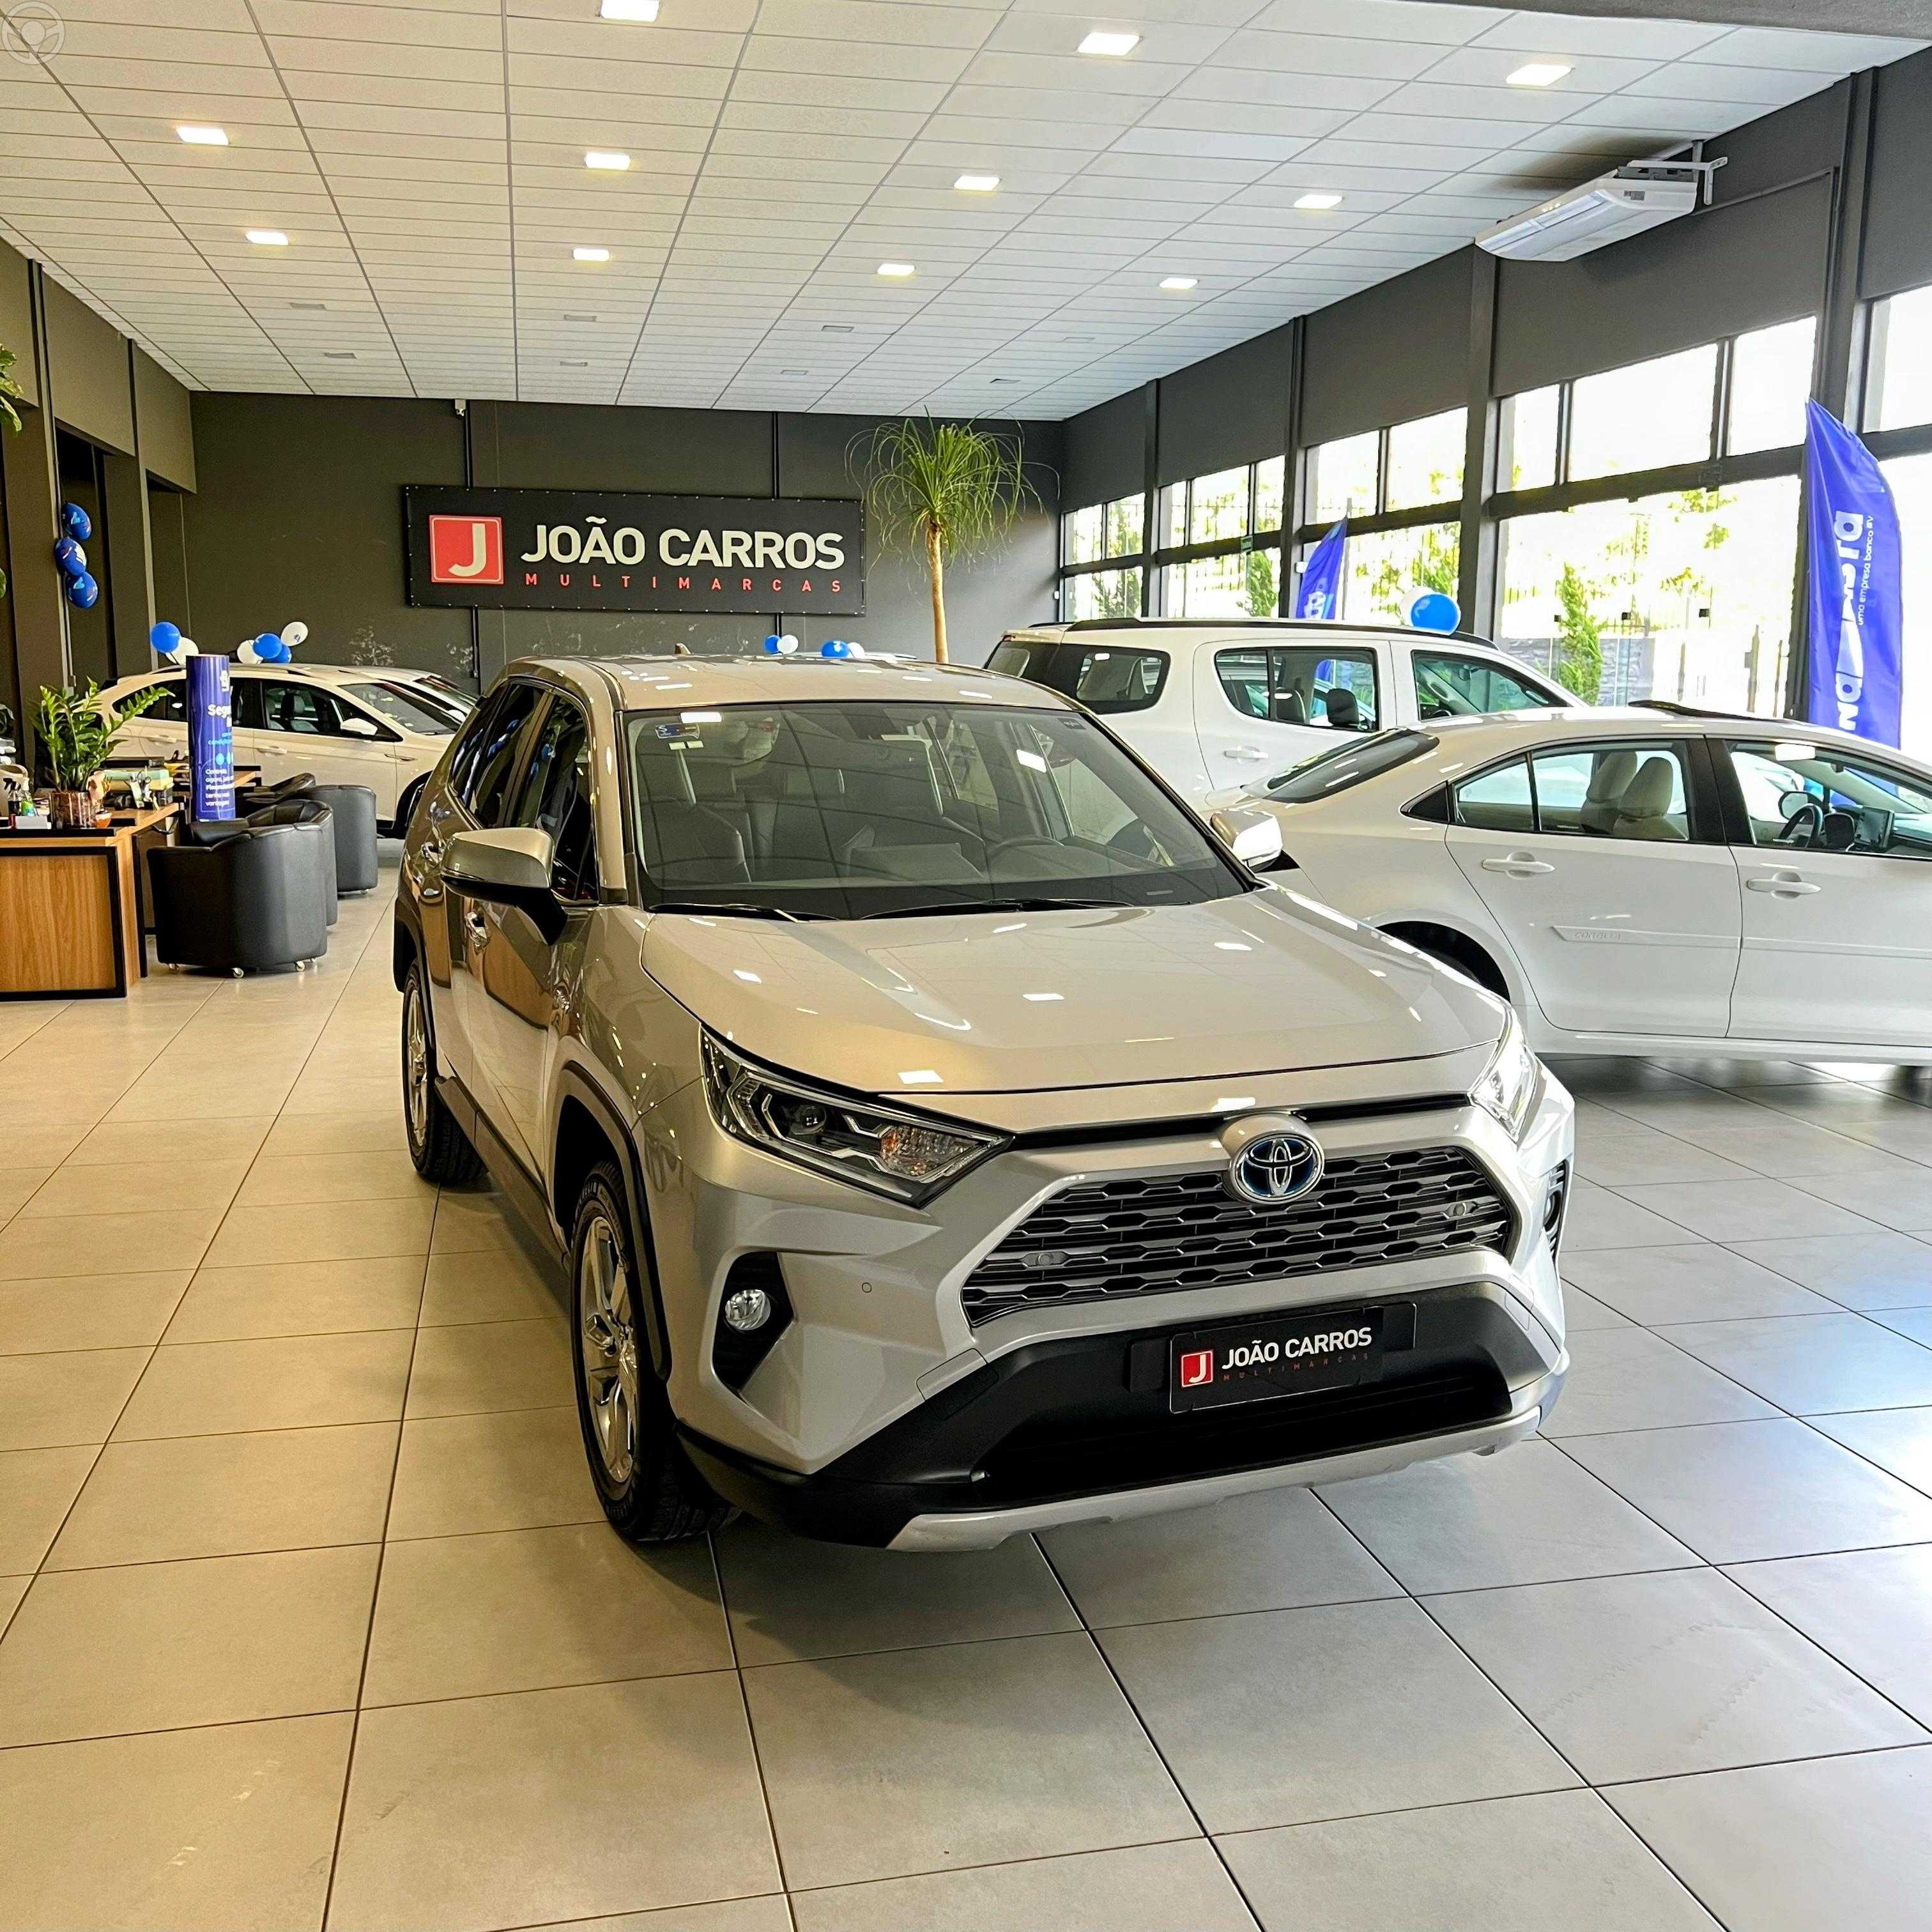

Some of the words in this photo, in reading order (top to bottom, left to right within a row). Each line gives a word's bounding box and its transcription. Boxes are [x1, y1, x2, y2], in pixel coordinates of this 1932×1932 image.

[521, 516, 645, 565] JOÃO
[659, 528, 845, 570] CARROS
[1864, 530, 1874, 562] banco
[525, 572, 841, 593] MULTIMARCAS
[1859, 562, 1871, 603] empresa
[1857, 603, 1866, 626] uma
[1222, 1340, 1279, 1370] JOÃO
[1285, 1327, 1372, 1358] CARROS
[1223, 1353, 1368, 1381] MULTIMARCAS
